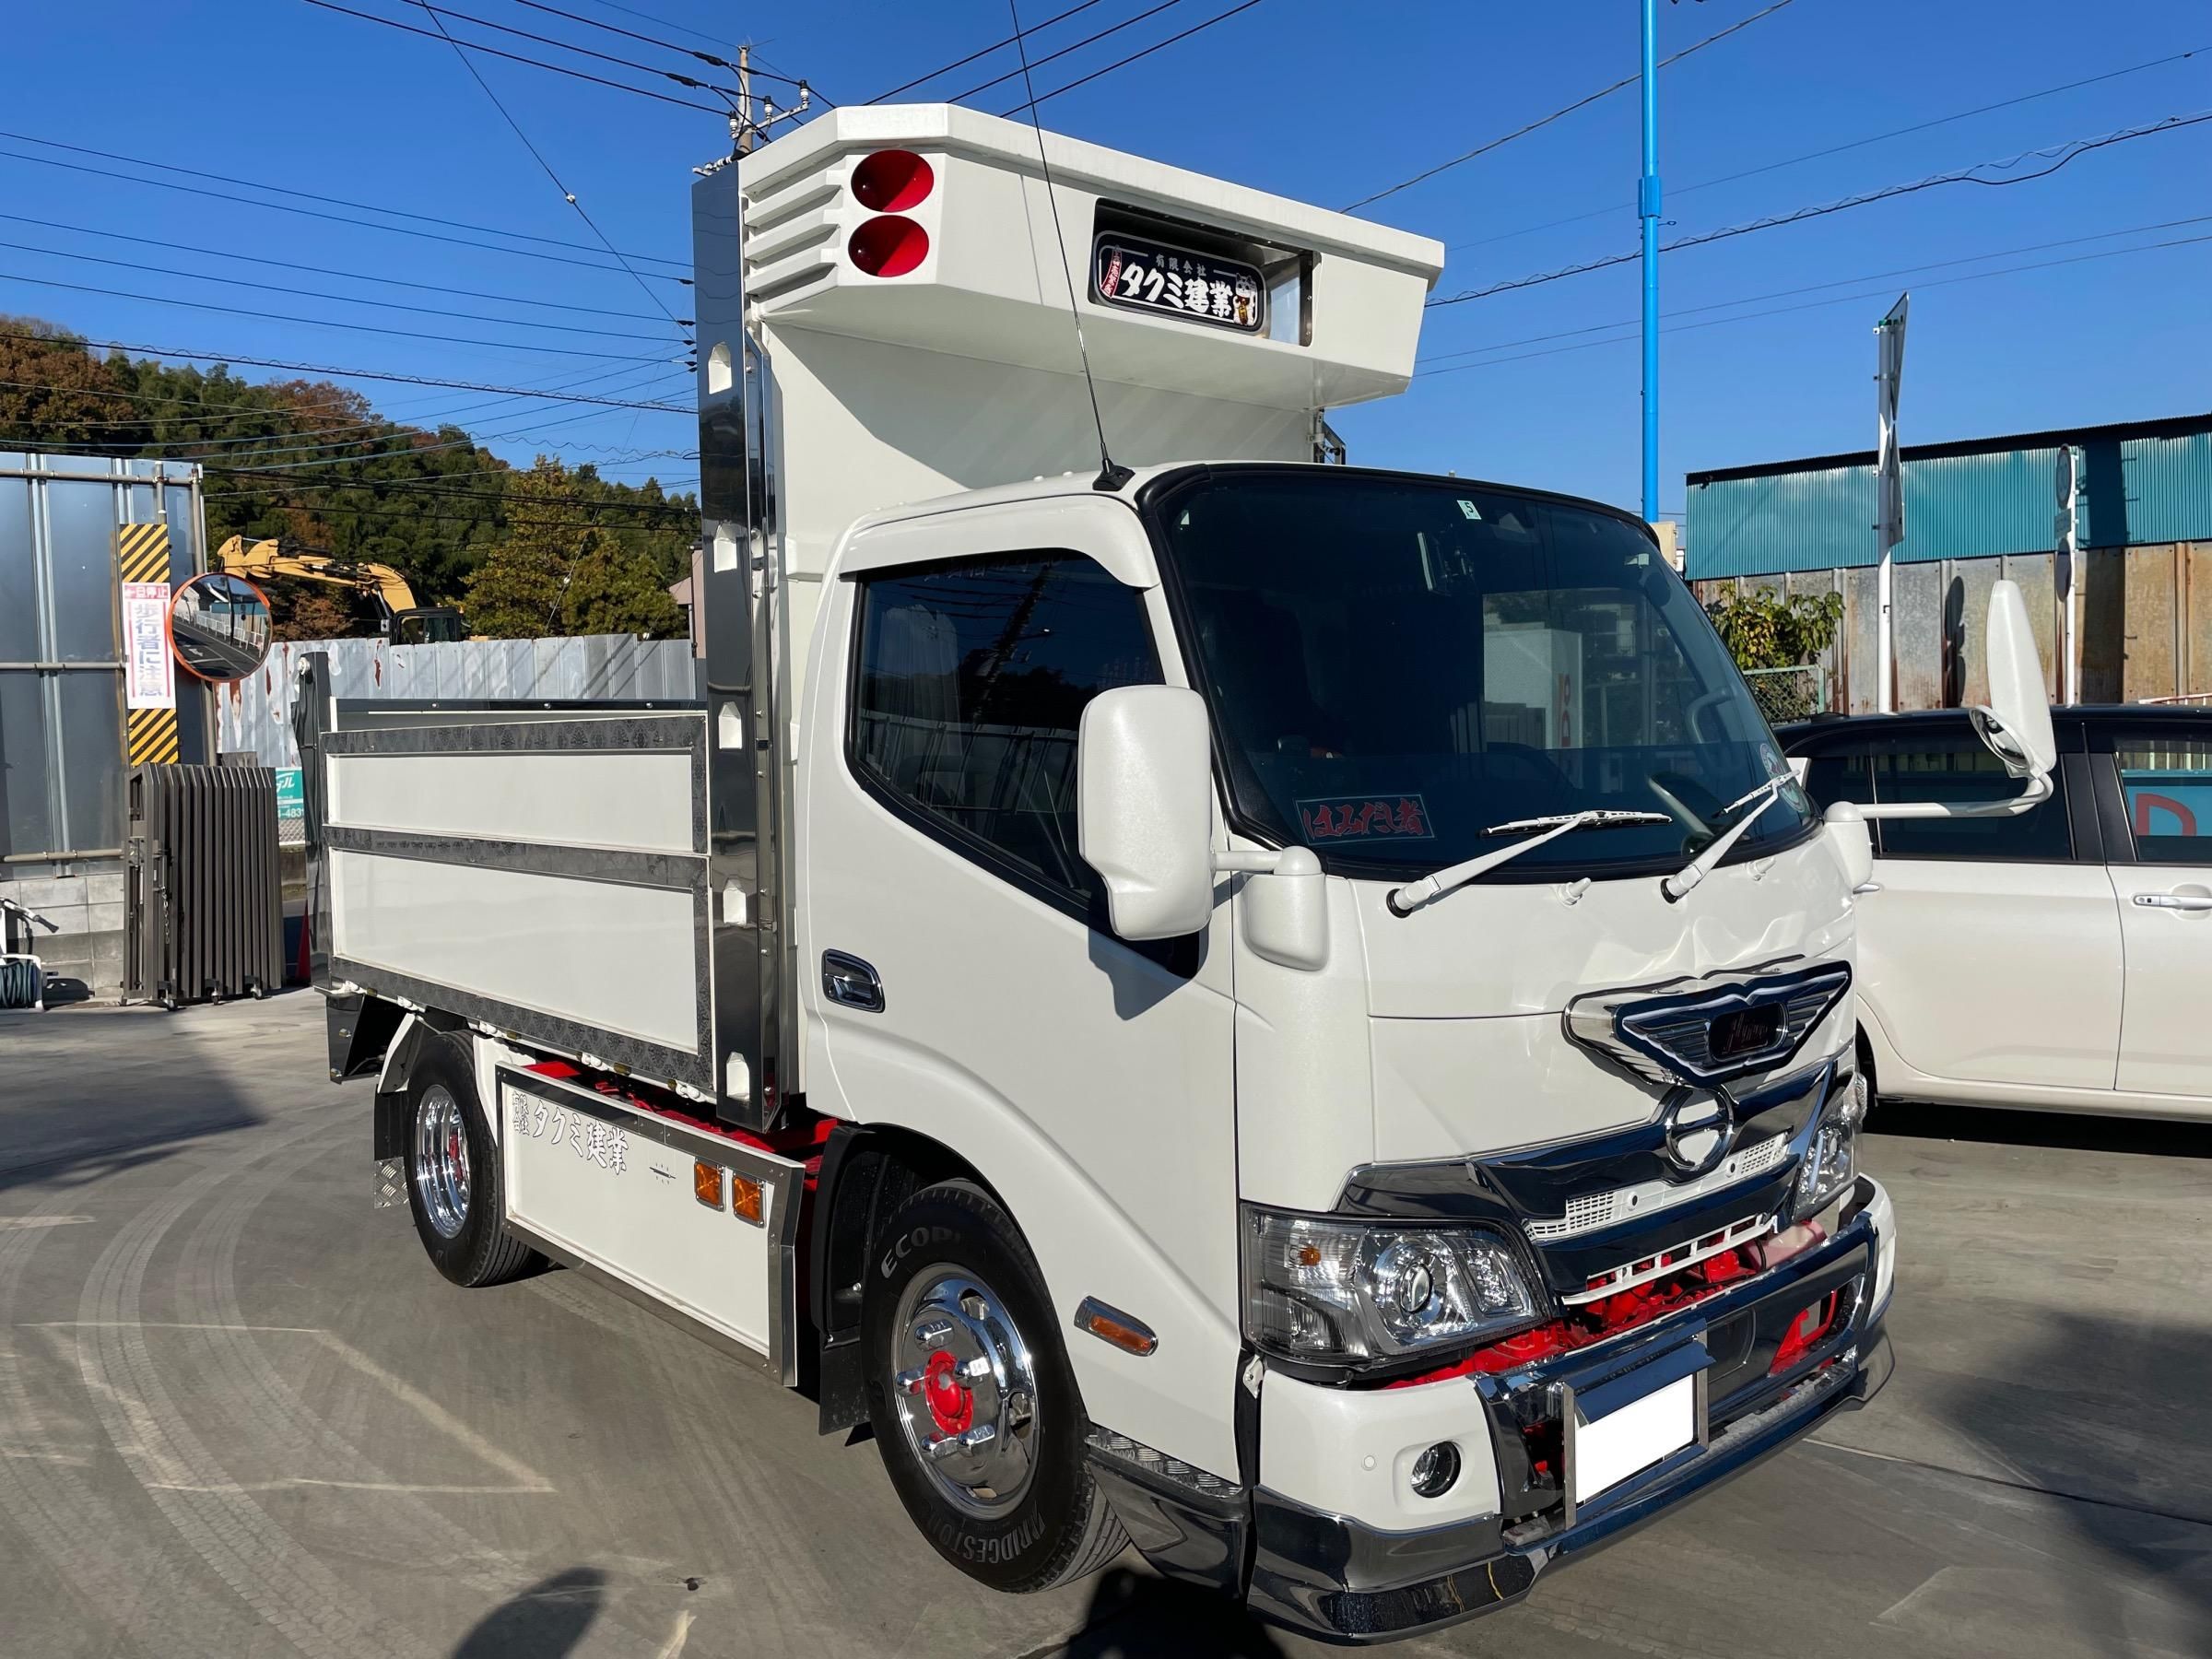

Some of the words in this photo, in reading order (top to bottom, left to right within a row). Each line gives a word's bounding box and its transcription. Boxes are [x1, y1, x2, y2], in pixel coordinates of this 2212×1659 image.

[1121, 262, 1232, 317] タクミ建業
[1156, 253, 1206, 276] 有限会社
[134, 603, 163, 698] 歩行者に注意
[533, 1100, 629, 1175] タクミ建業
